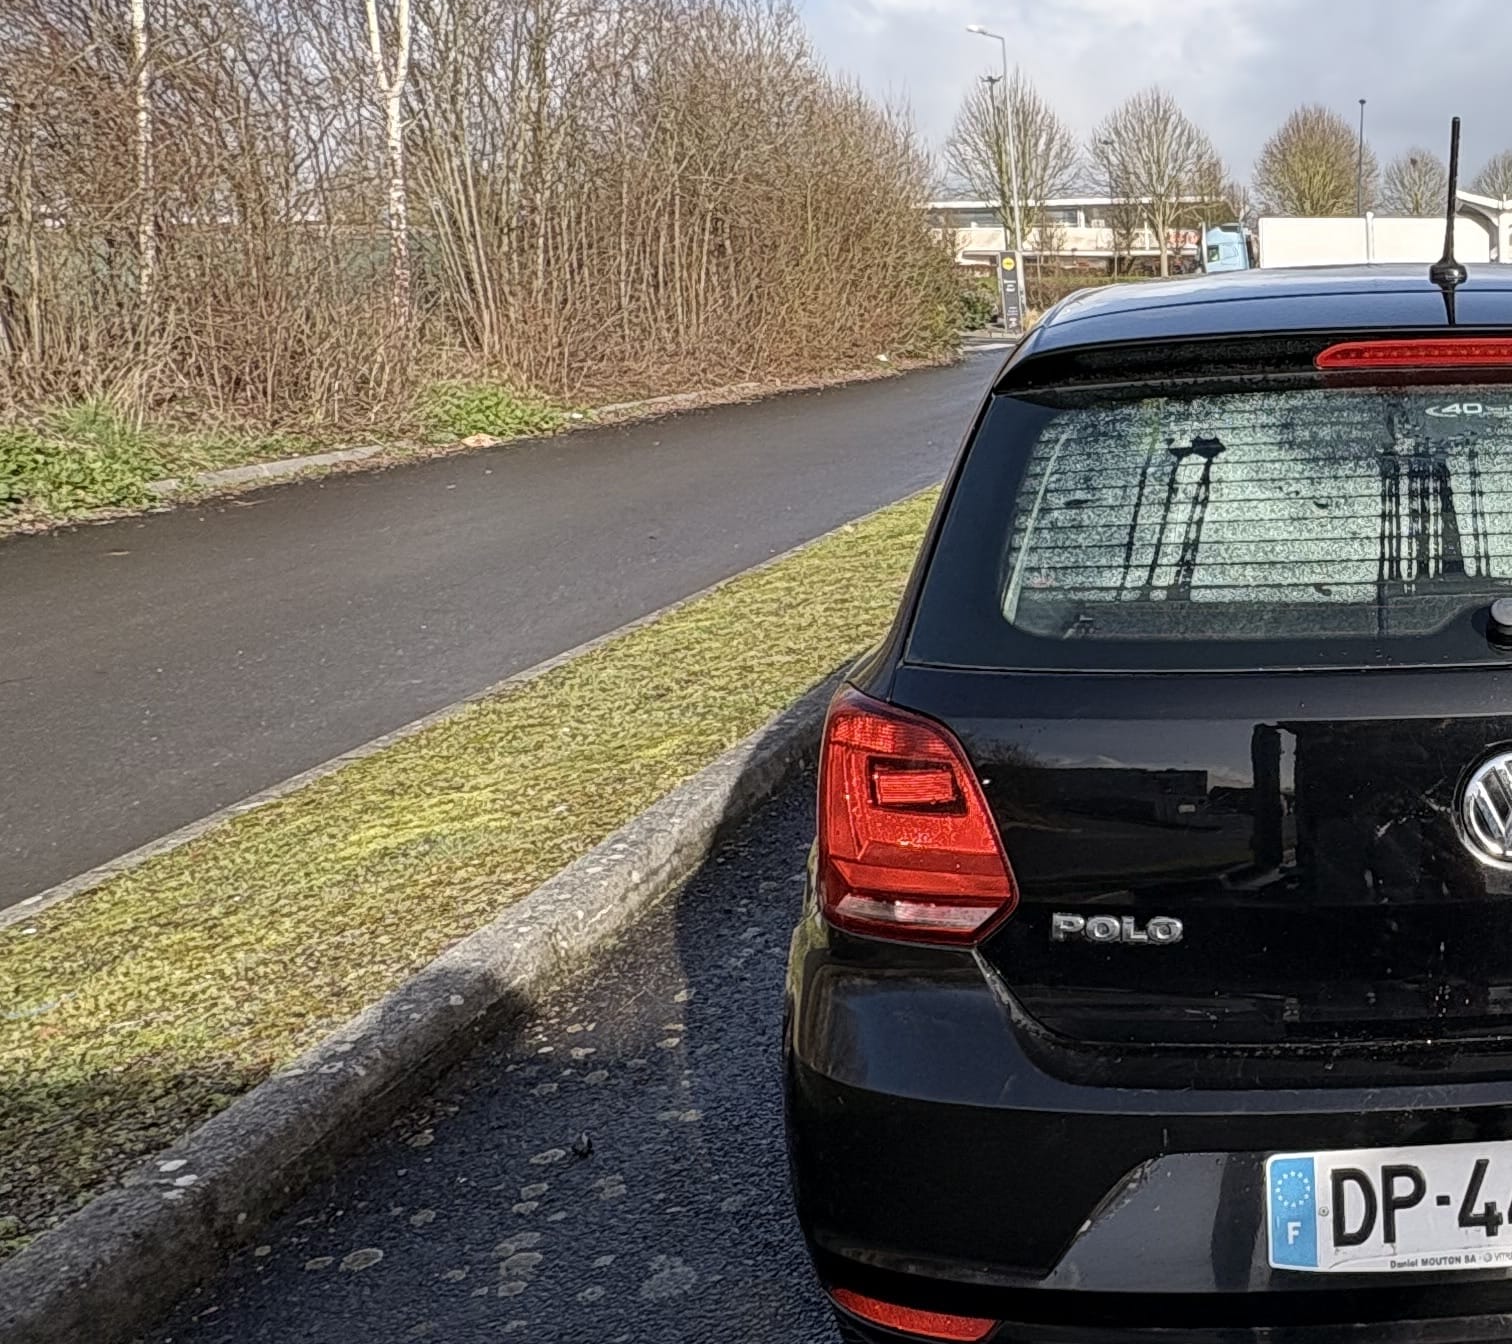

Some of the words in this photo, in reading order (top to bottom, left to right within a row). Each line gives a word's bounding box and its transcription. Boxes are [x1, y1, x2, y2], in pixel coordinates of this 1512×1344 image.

[1441, 403, 1482, 415] 40
[1050, 912, 1184, 944] POLO
[1287, 1221, 1302, 1245] F
[1390, 1259, 1418, 1269] Daniel
[1421, 1256, 1462, 1266] MOUTON
